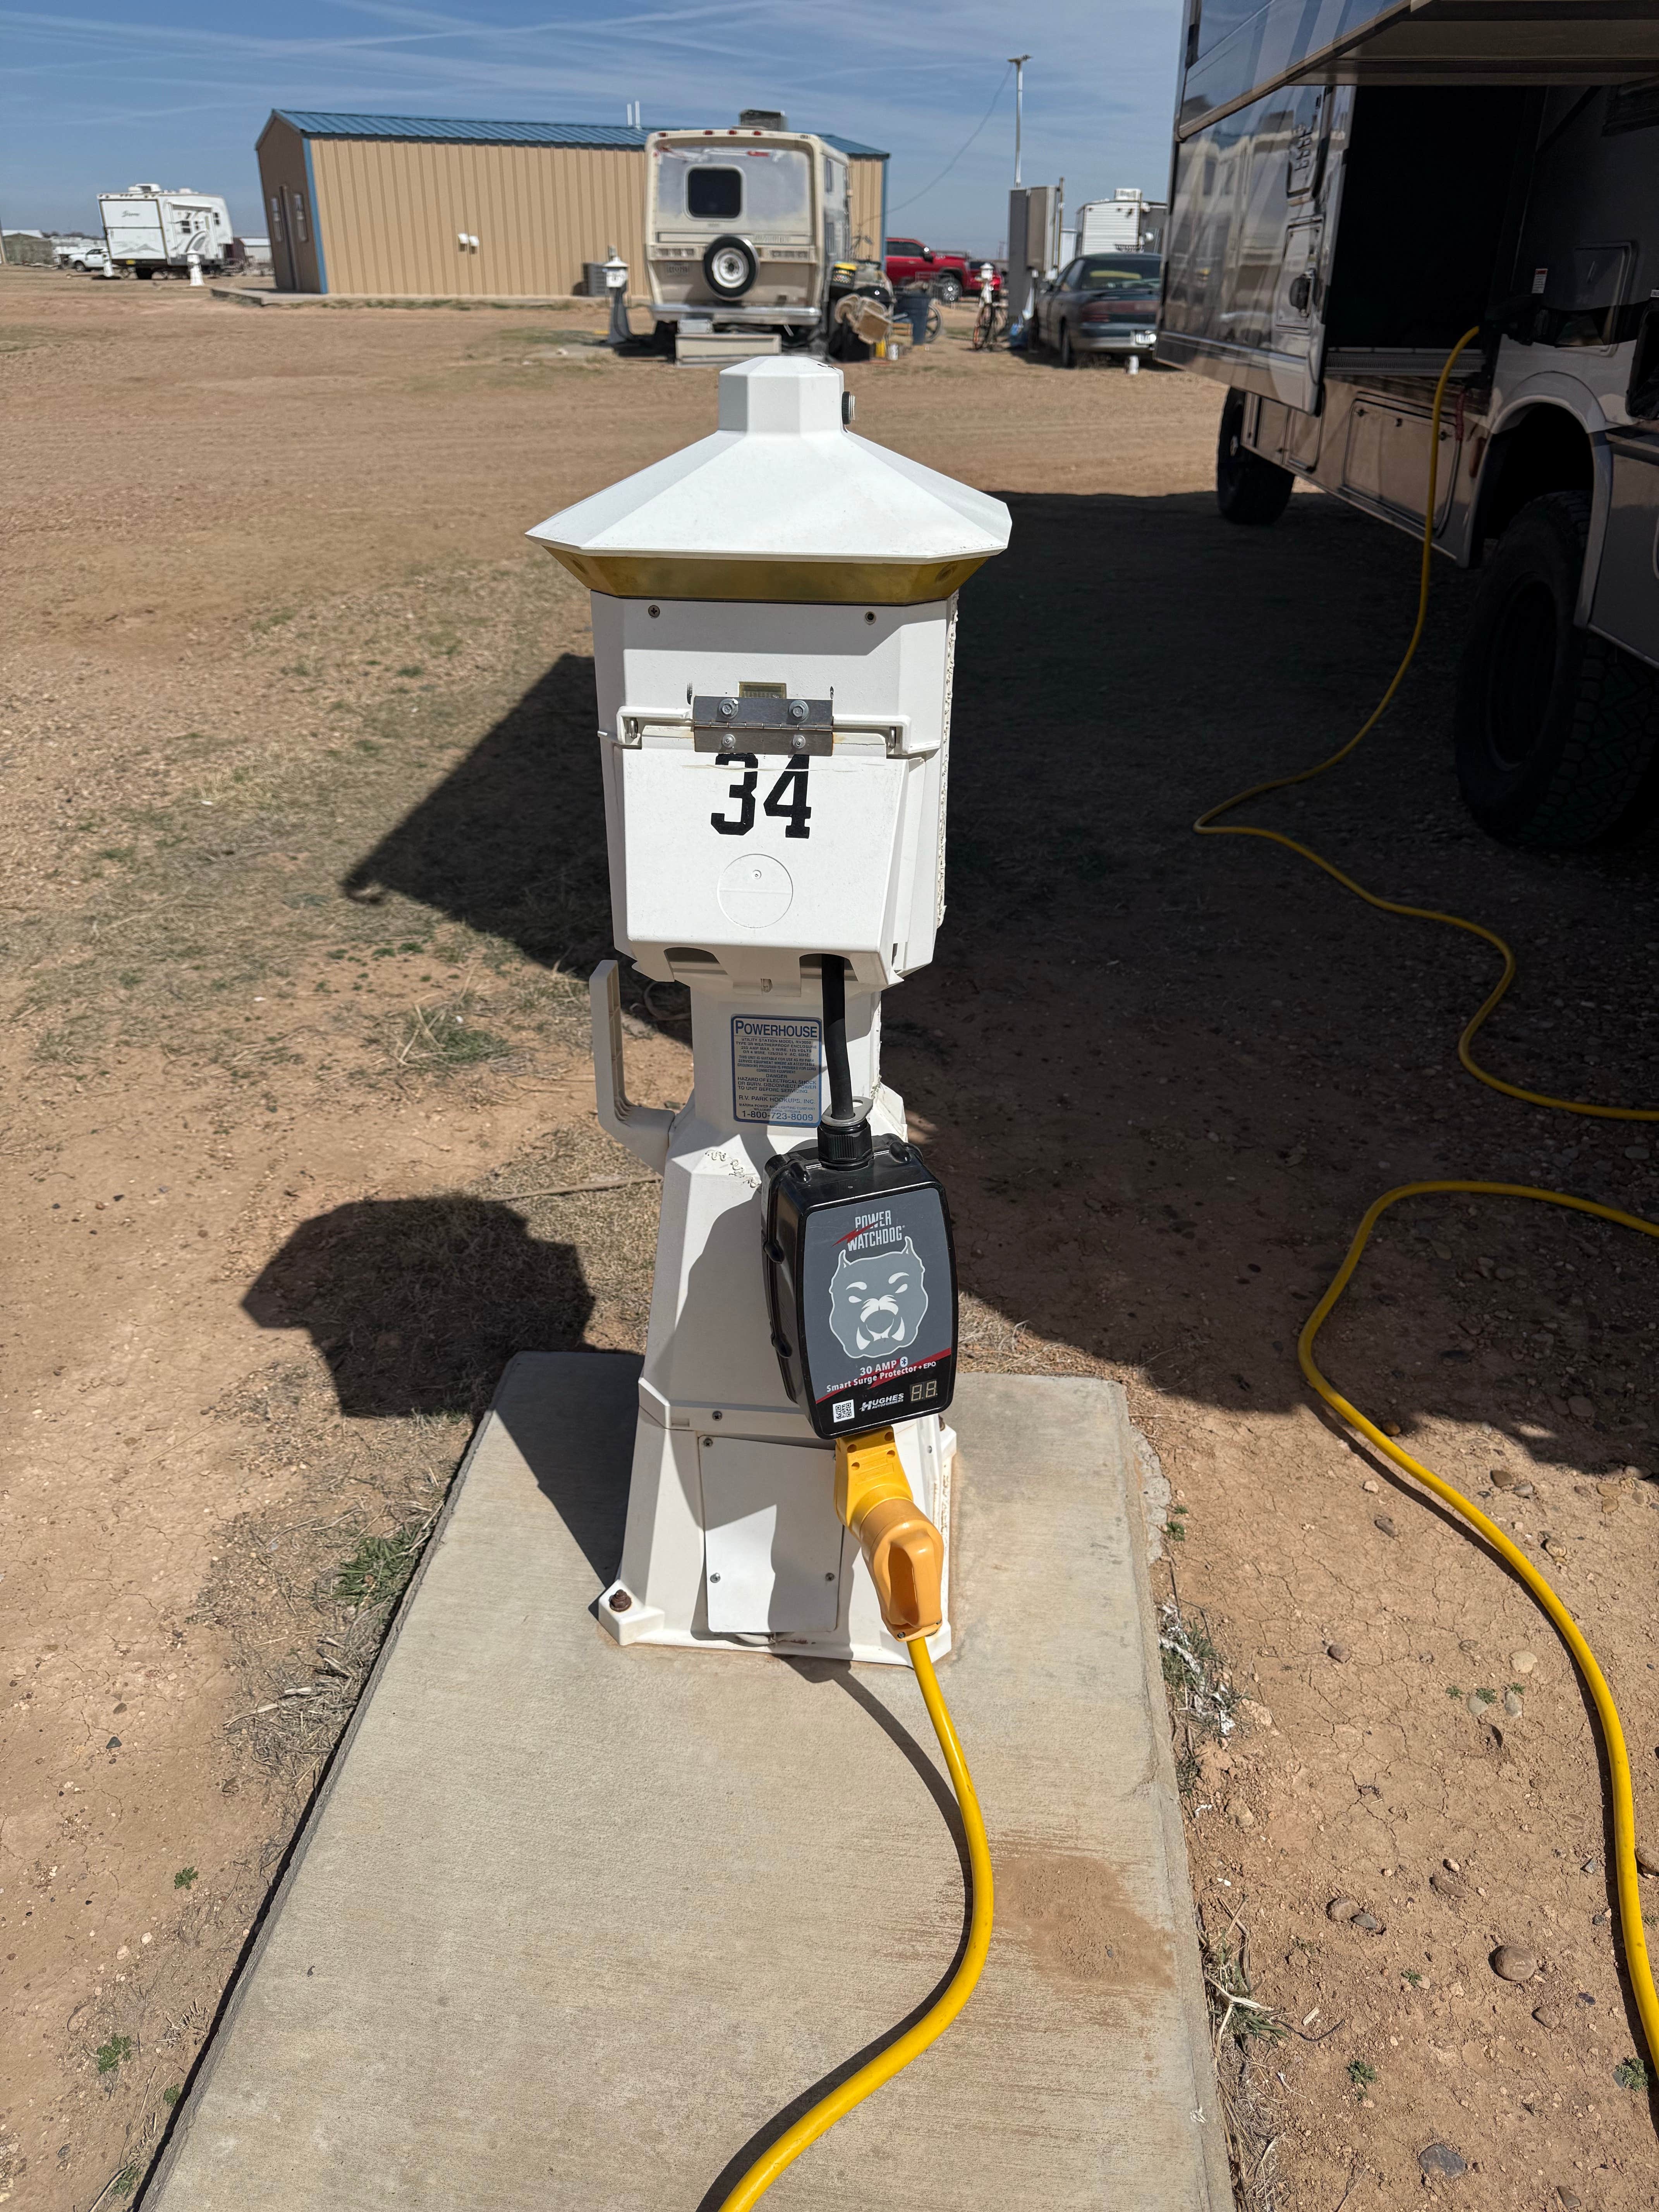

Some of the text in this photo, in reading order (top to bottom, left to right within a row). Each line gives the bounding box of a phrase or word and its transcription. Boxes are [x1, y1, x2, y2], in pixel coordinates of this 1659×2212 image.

[711, 753, 812, 839] 34
[735, 1020, 817, 1037] POWERHOUSE
[742, 1110, 813, 1121] 1-800-723-8009
[855, 1210, 891, 1231] POWER
[860, 1360, 897, 1376] 30 AMP
[826, 1381, 852, 1392] Smart
[854, 1376, 878, 1386] Surge
[880, 1366, 917, 1379] Protector
[860, 1393, 904, 1412] HUGHES
[871, 1399, 904, 1409] AUTOFORMERS
